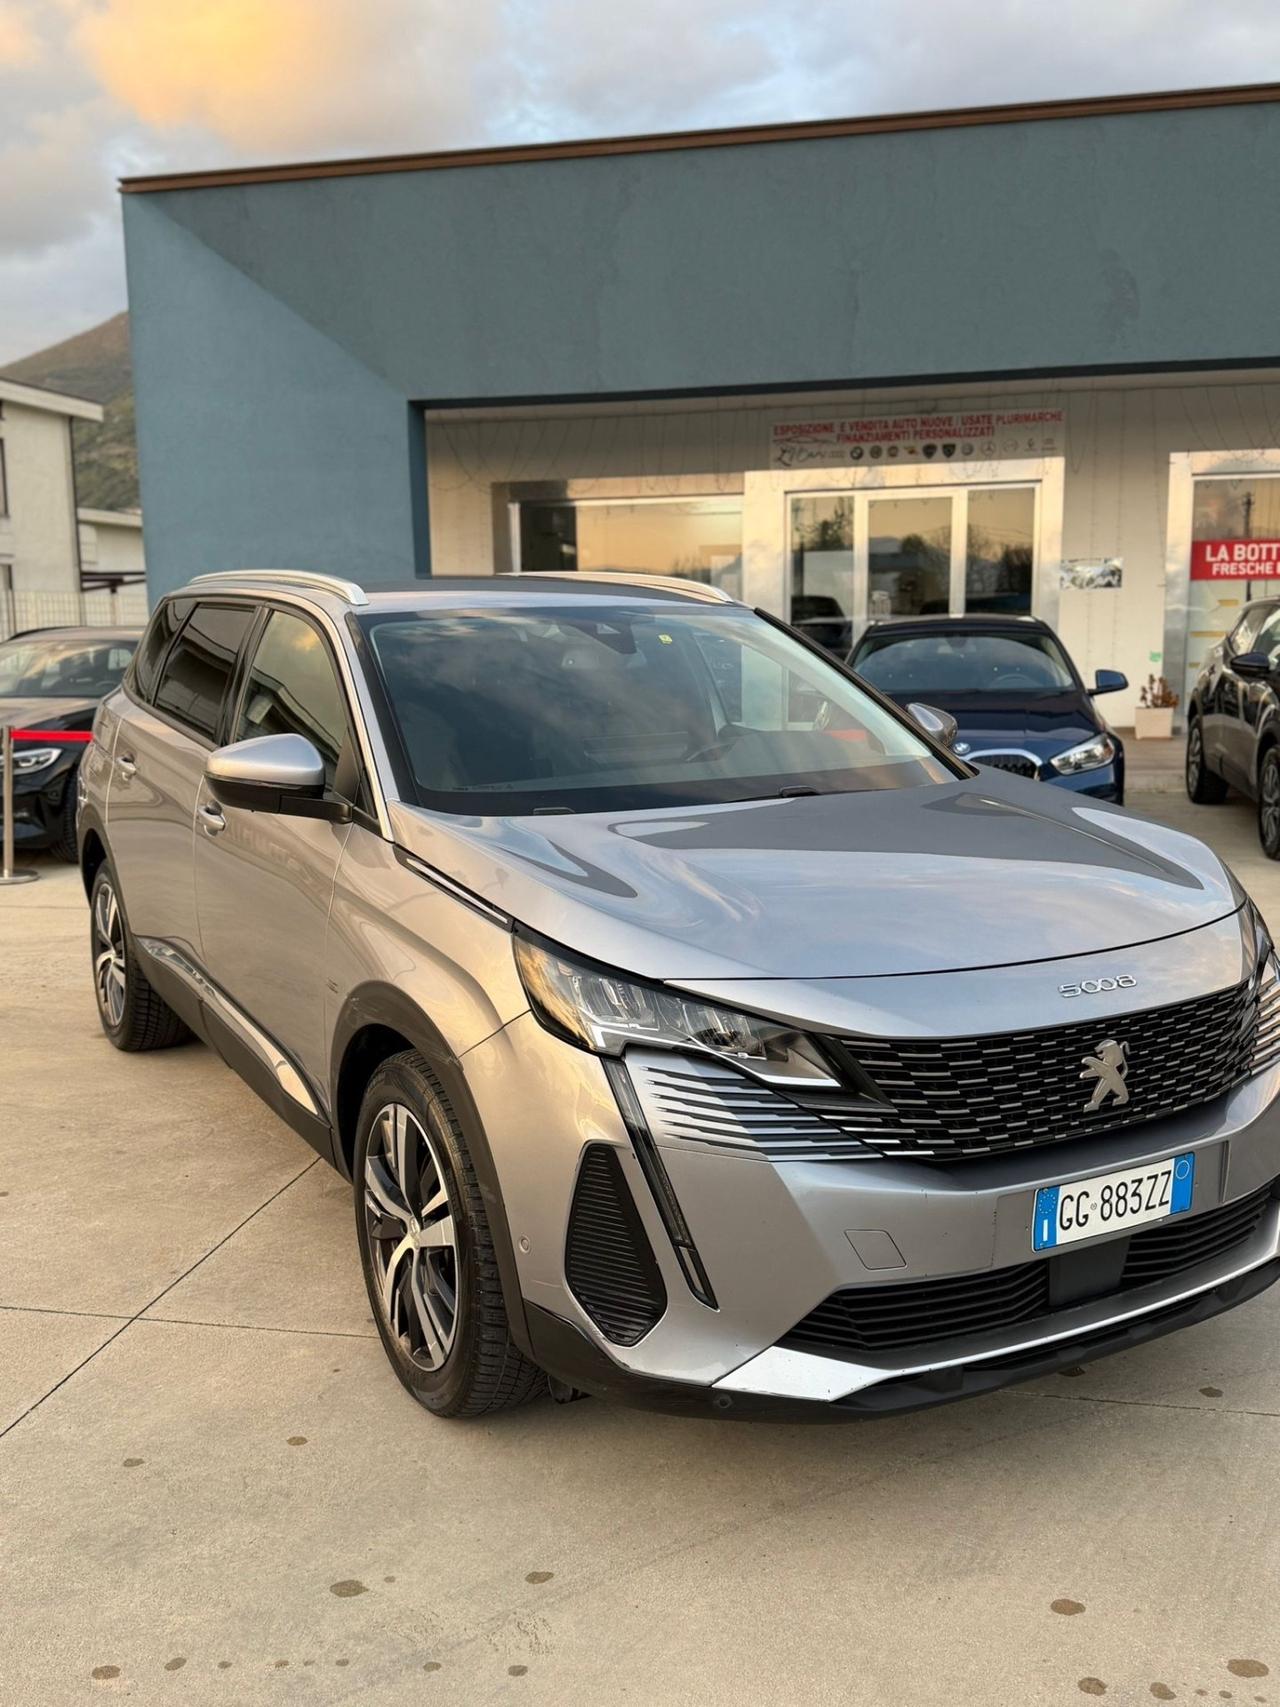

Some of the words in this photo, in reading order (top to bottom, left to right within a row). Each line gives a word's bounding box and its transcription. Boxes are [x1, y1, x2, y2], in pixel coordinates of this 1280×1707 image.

[774, 422, 834, 436] ESPOSIZIONE
[840, 422, 847, 432] E
[849, 420, 889, 432] VENDITA
[892, 418, 917, 430] AUTO
[920, 416, 953, 428] NUOVE
[961, 414, 993, 425] USATE
[996, 411, 1062, 425] PLURIMARCHE
[836, 430, 910, 443] FINANZIAMENTI
[913, 425, 995, 439] PERSONALIZZATI
[1206, 544, 1230, 562] LA
[1233, 543, 1280, 561] BOTT
[1212, 561, 1274, 576] FRESCHE
[1058, 974, 1137, 998] 5008
[1059, 1190, 1090, 1231] GG
[1100, 1169, 1172, 1221] 883ZZ
